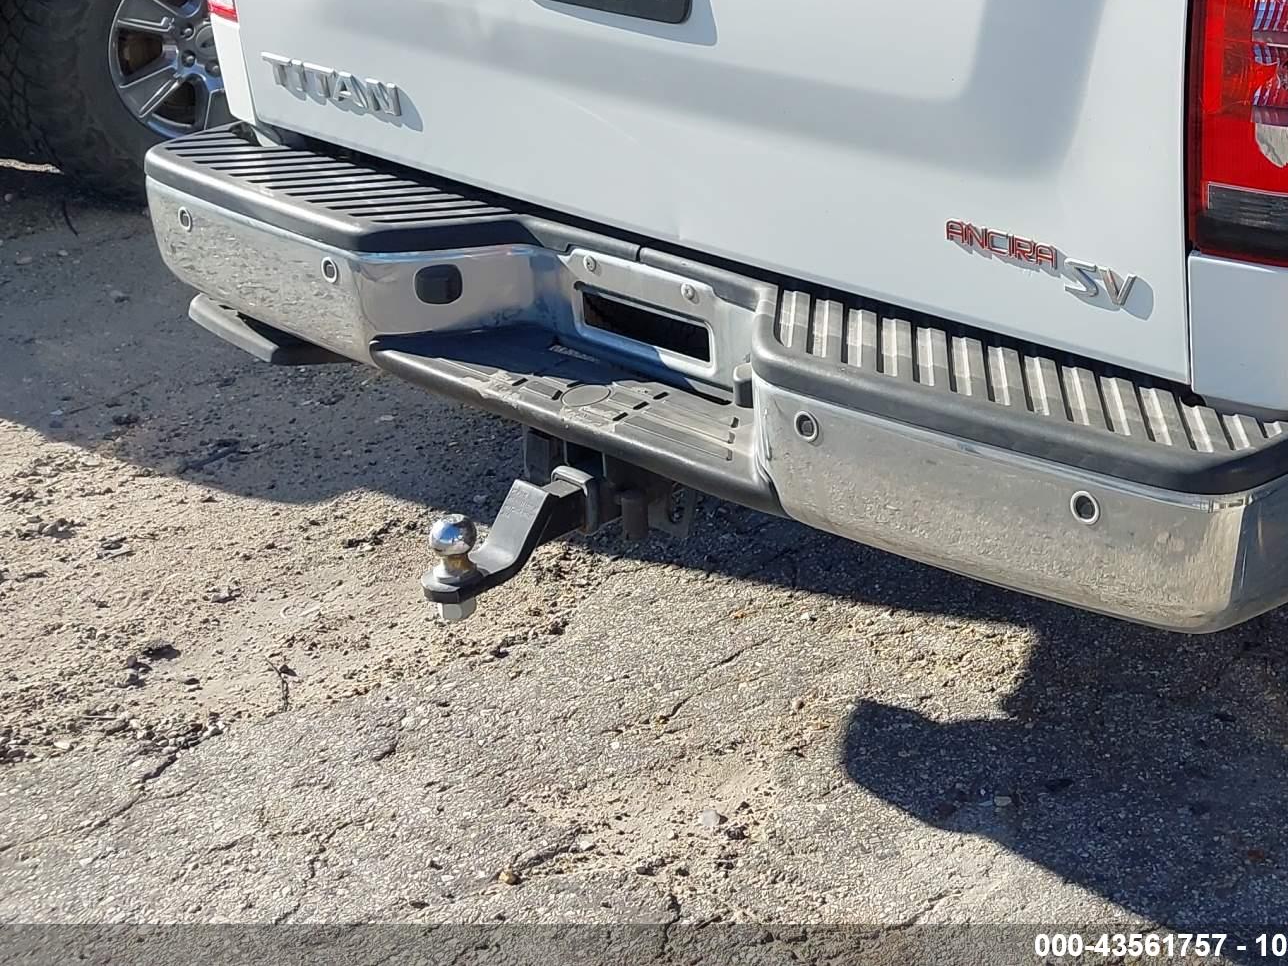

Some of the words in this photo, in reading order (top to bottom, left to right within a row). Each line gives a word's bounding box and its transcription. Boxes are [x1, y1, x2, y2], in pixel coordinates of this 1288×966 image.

[260, 50, 402, 117] TITAN
[945, 218, 1058, 270] ANCIRA
[1064, 257, 1138, 307] SV
